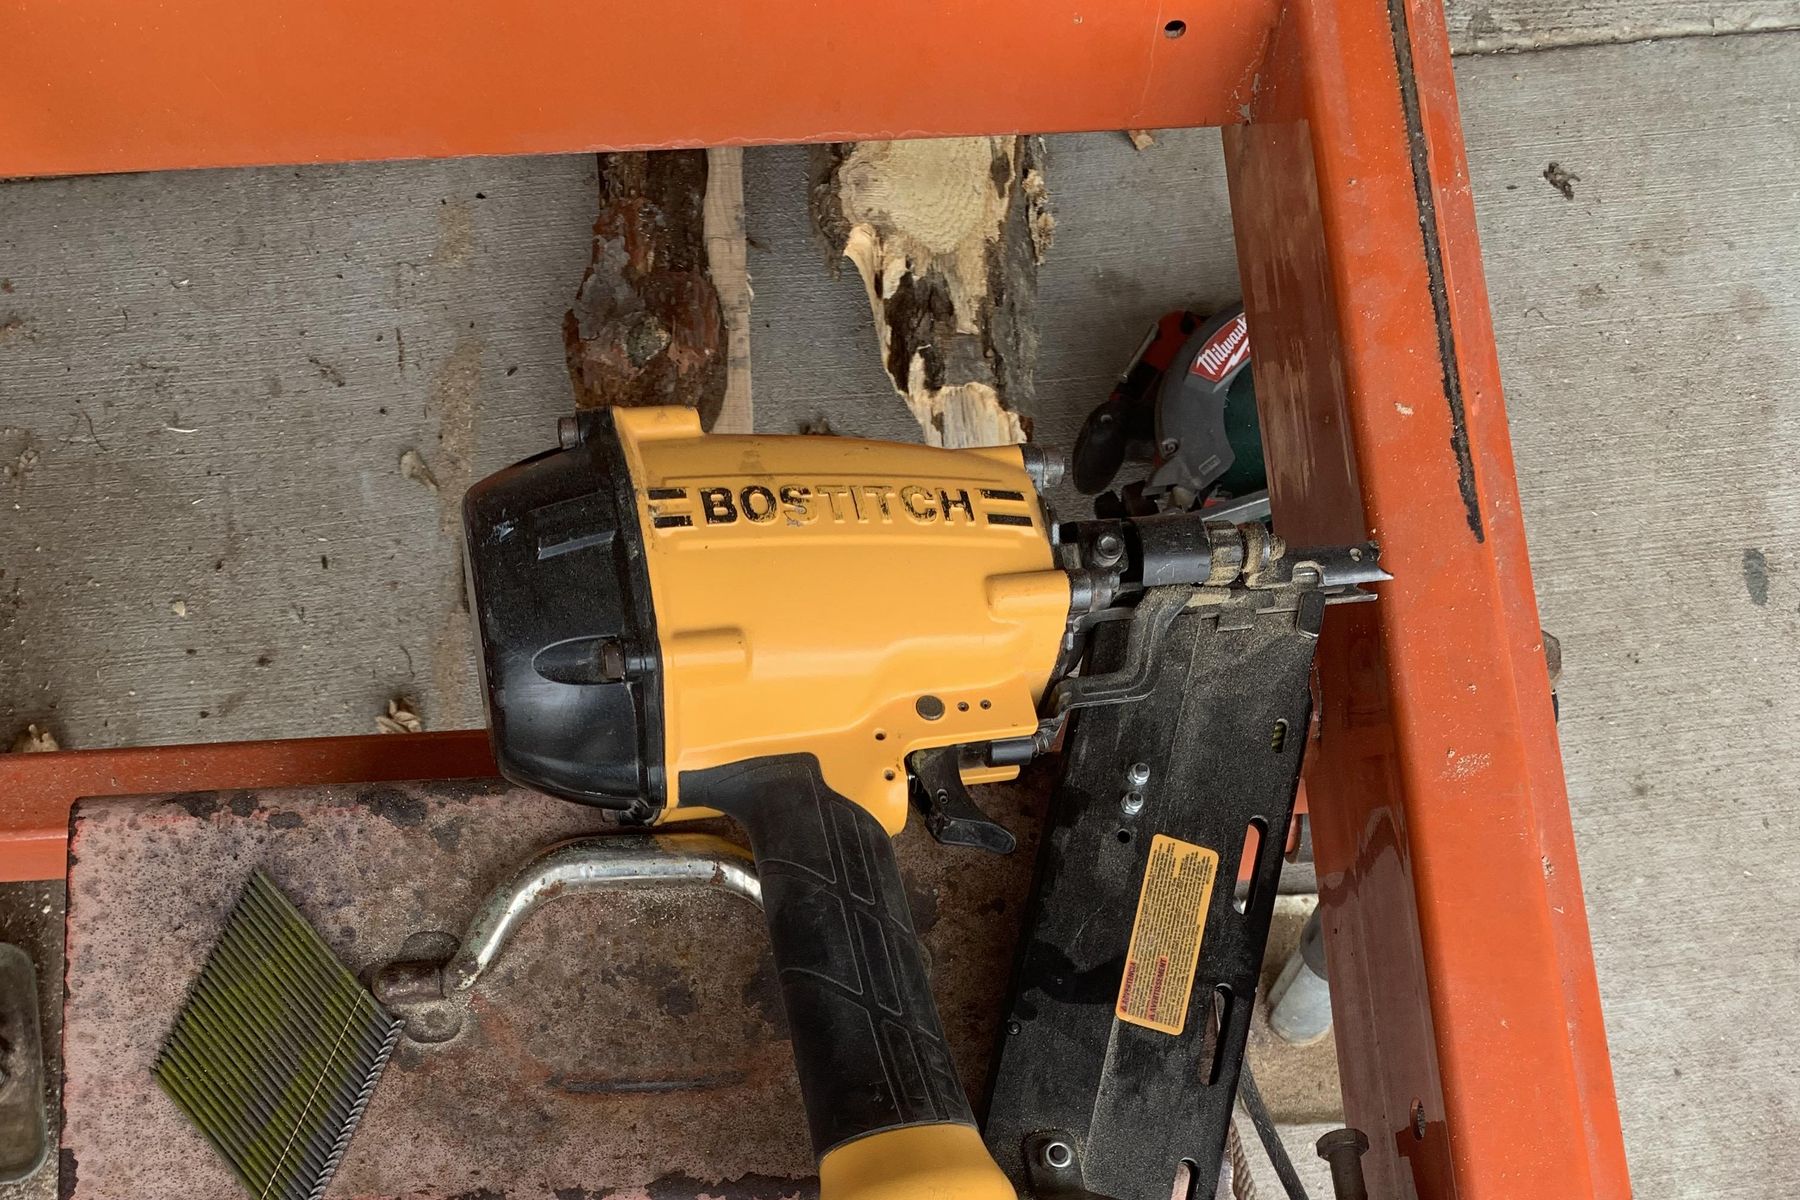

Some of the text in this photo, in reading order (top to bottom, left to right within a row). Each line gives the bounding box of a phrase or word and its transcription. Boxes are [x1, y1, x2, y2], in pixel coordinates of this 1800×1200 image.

[1196, 316, 1247, 375] Milwauk
[698, 485, 976, 526] BOSTITCH
[1149, 957, 1167, 1012] AVERTISSEMENT
